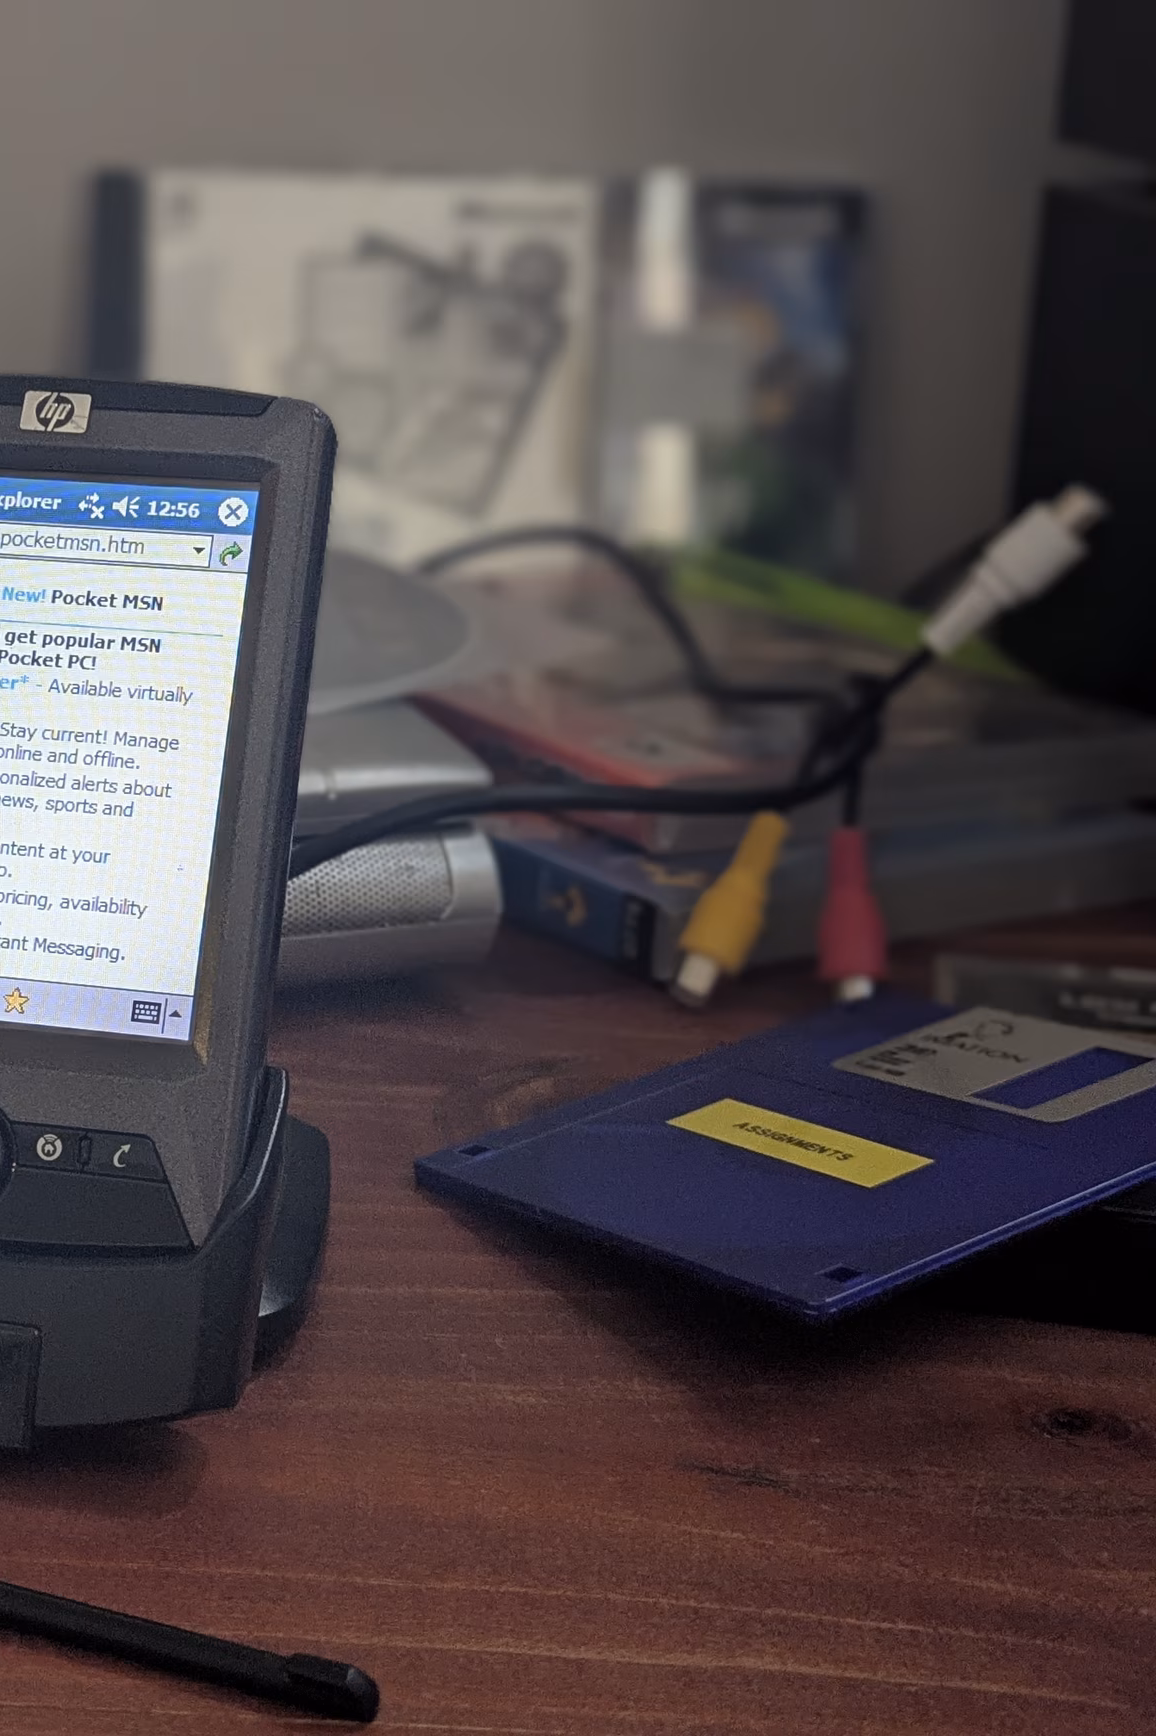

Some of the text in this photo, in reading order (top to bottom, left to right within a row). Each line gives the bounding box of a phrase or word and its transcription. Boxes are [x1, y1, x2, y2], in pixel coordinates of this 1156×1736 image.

[147, 501, 200, 519] 12:56
[2, 586, 163, 611] New! Pocket MSN
[4, 629, 37, 647] get
[42, 633, 115, 652] popular
[120, 636, 161, 654] MSN
[68, 654, 97, 671] PC!
[48, 679, 122, 699] Available
[128, 684, 193, 705] virtually
[0, 722, 37, 742] Stay
[41, 725, 108, 745] current!
[113, 730, 180, 753] Manage
[47, 747, 78, 765] and
[83, 750, 140, 770] offline.
[70, 774, 119, 795] alerts
[122, 778, 173, 800] about
[44, 797, 97, 816] sports
[102, 800, 134, 818] and
[49, 844, 67, 861] at
[72, 847, 111, 866] your
[59, 892, 148, 919] availability
[33, 937, 125, 963] Messaging.
[732, 1121, 856, 1162] ASSIGNMENTS
